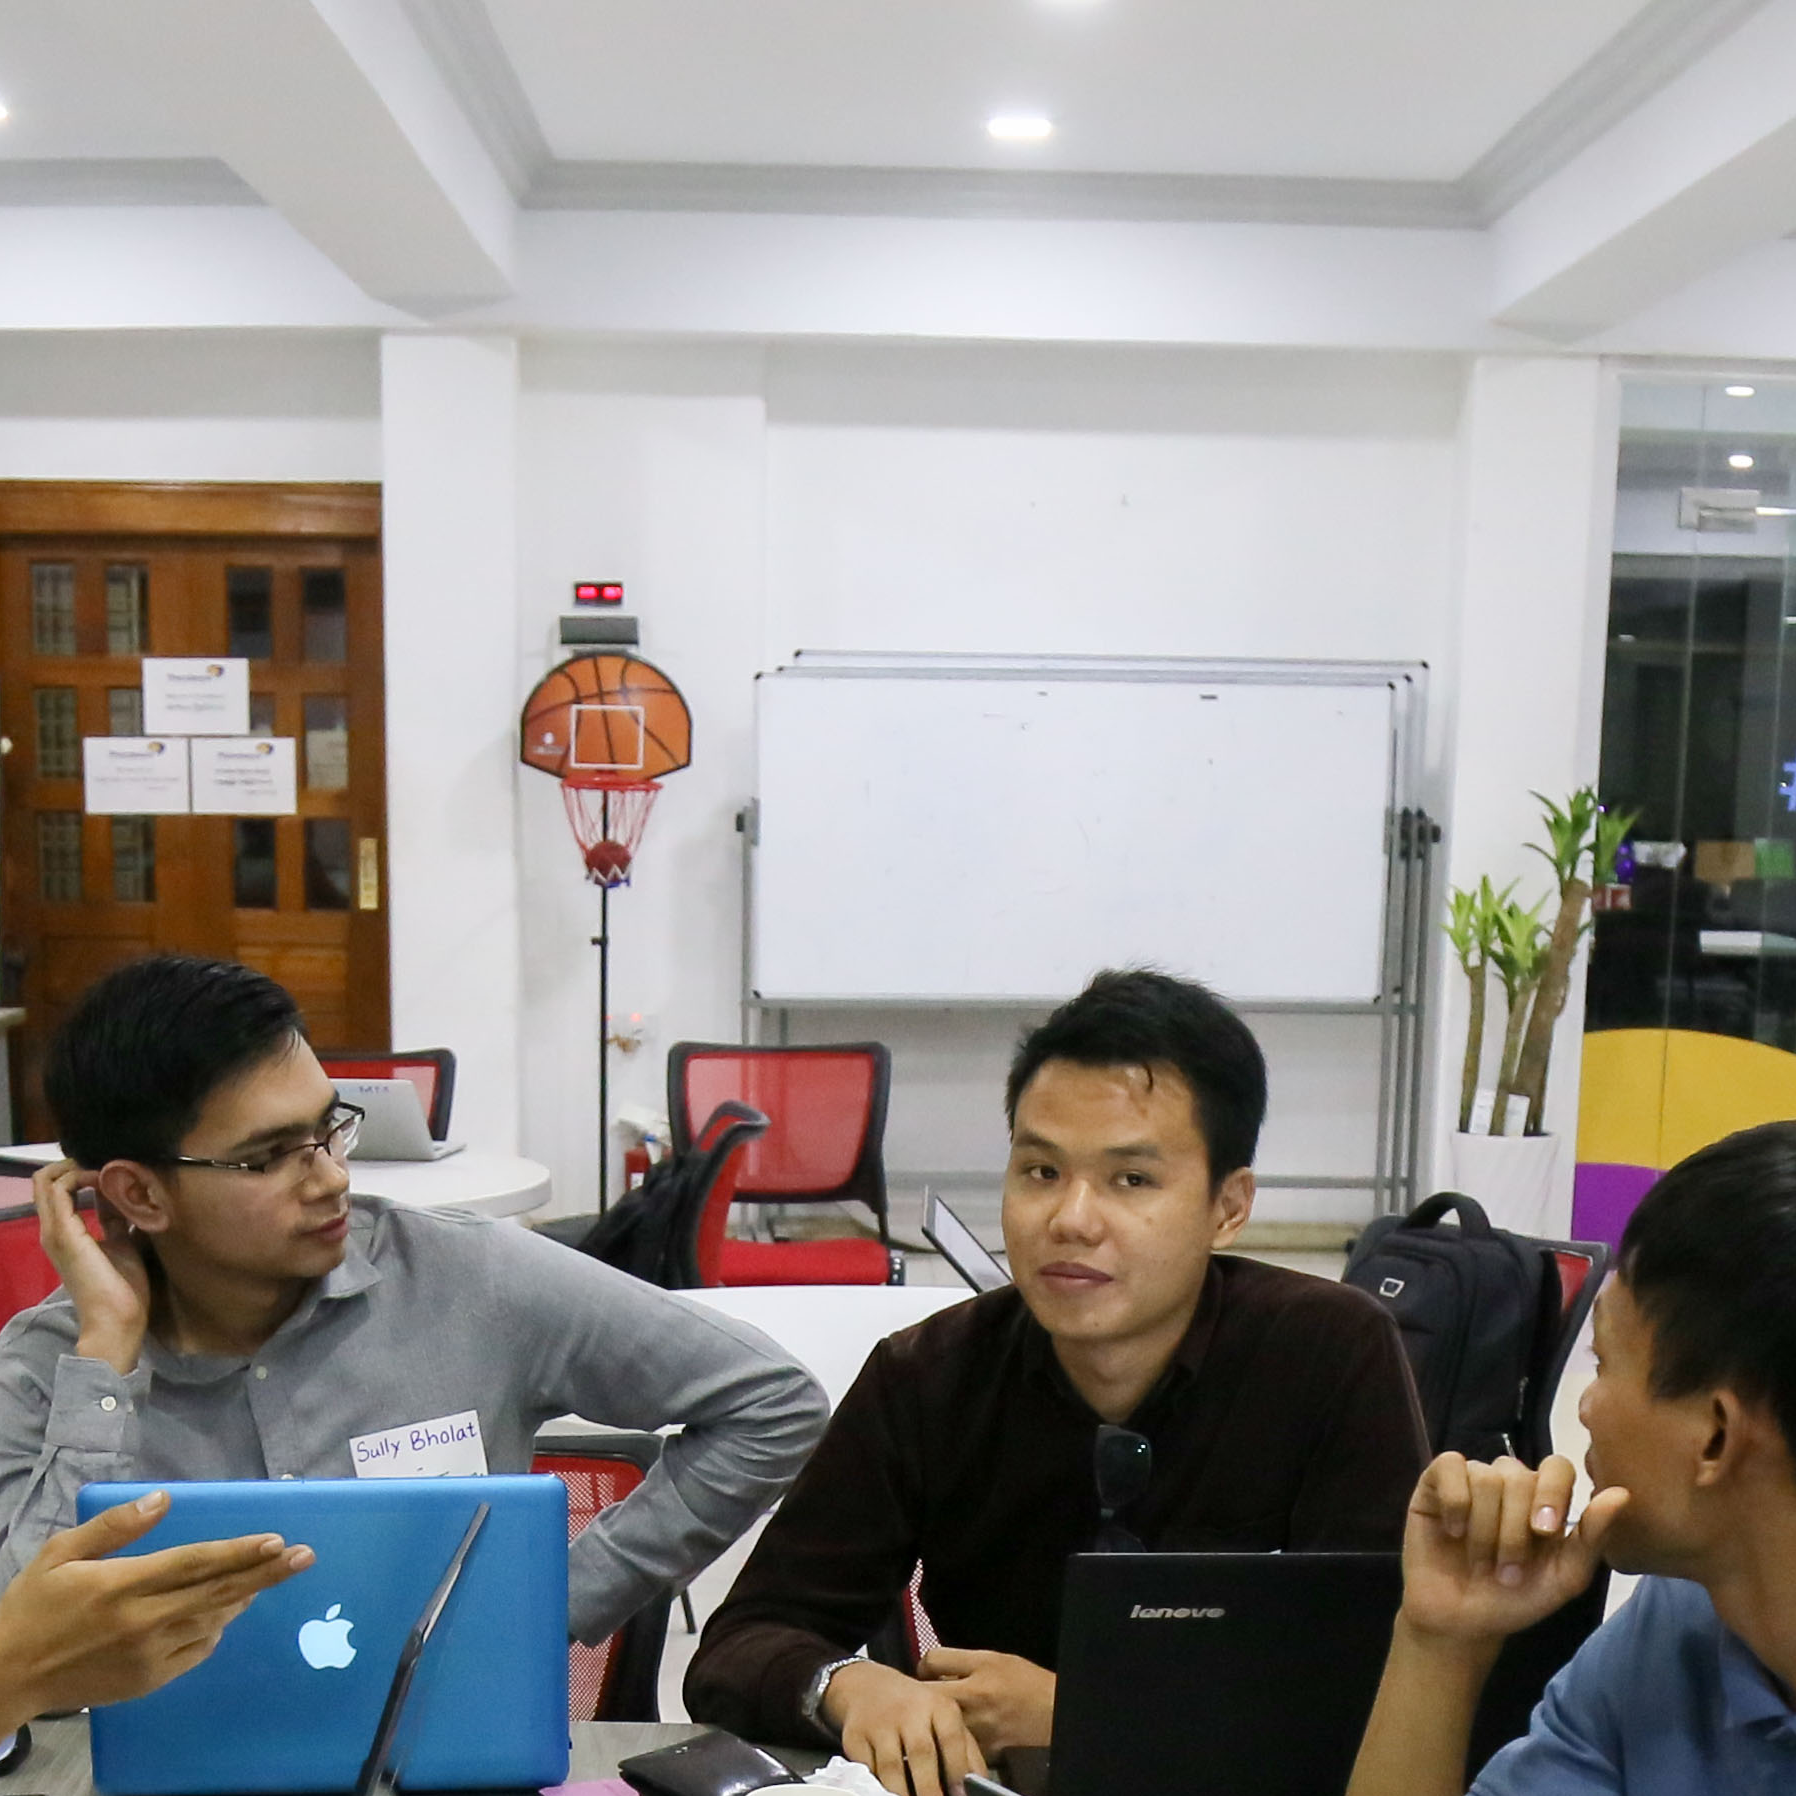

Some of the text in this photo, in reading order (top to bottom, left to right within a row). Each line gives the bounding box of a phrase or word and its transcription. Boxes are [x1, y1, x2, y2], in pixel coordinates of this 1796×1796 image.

[356, 1422, 476, 1463] Sully Bholat
[1129, 1604, 1227, 1619] lenovo
